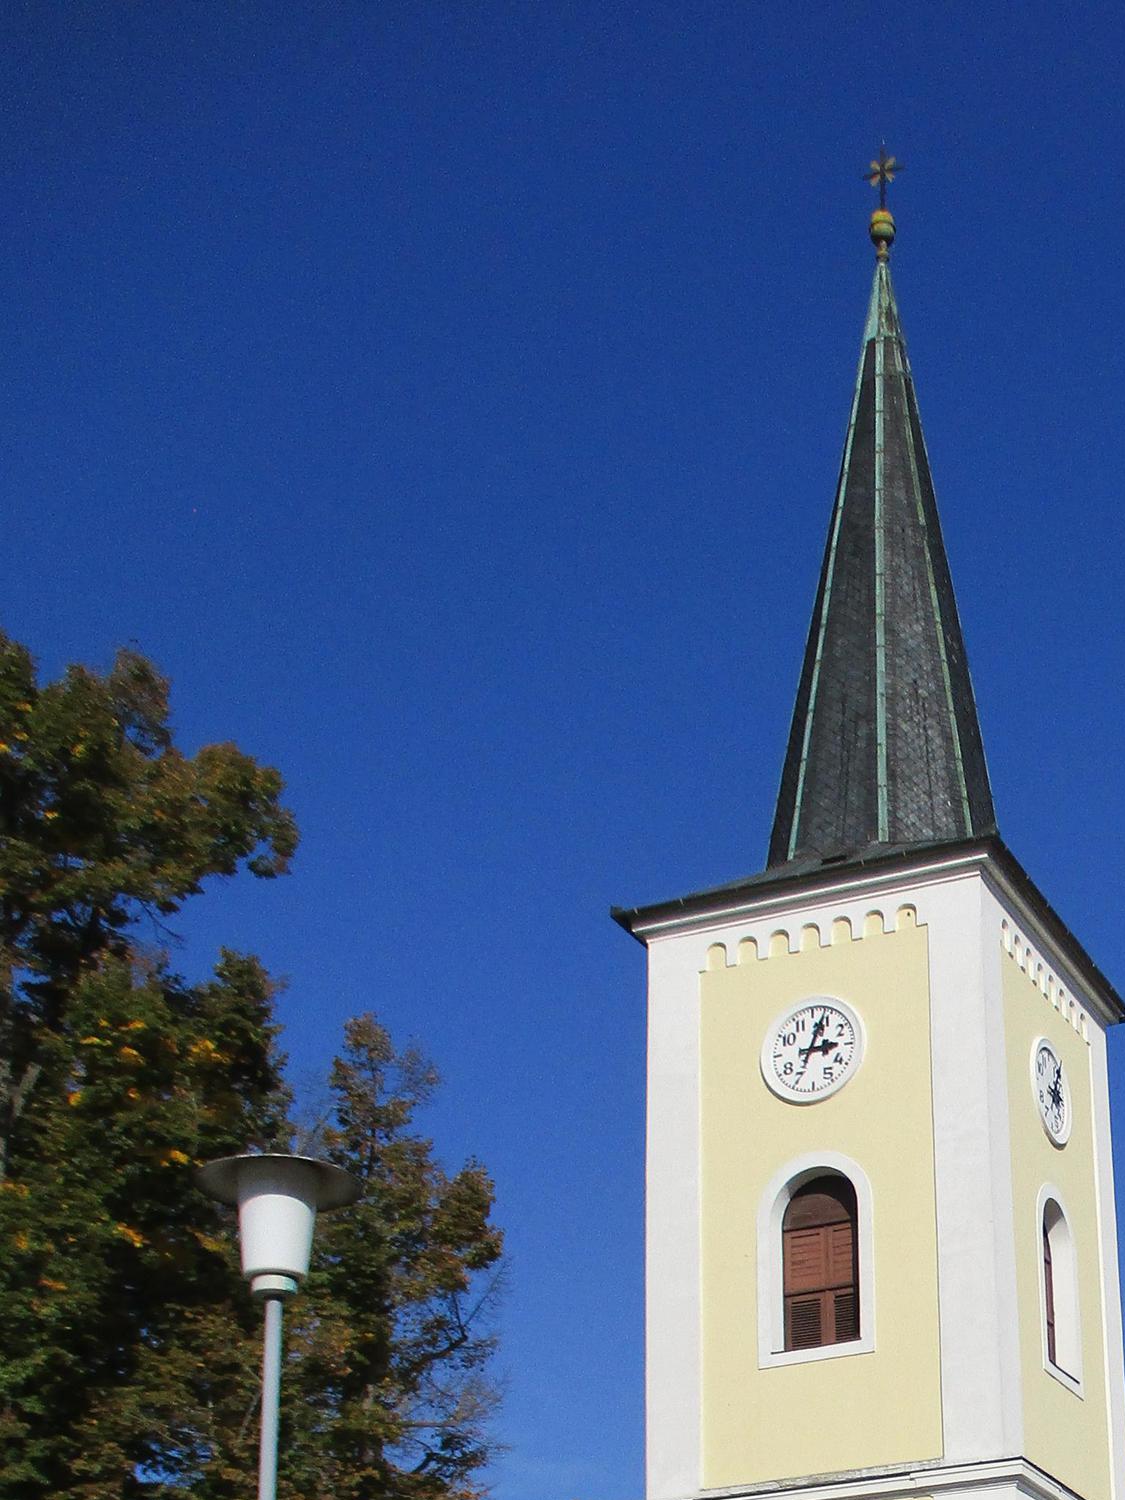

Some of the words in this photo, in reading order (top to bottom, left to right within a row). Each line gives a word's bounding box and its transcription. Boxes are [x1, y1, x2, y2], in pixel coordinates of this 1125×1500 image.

[795, 1018, 806, 1033] 11
[836, 1023, 845, 1037] 2
[782, 1032, 796, 1047] 10
[833, 1052, 843, 1065] 4
[783, 1061, 794, 1075] 8
[823, 1066, 834, 1079] 5
[794, 1071, 806, 1085] 7
